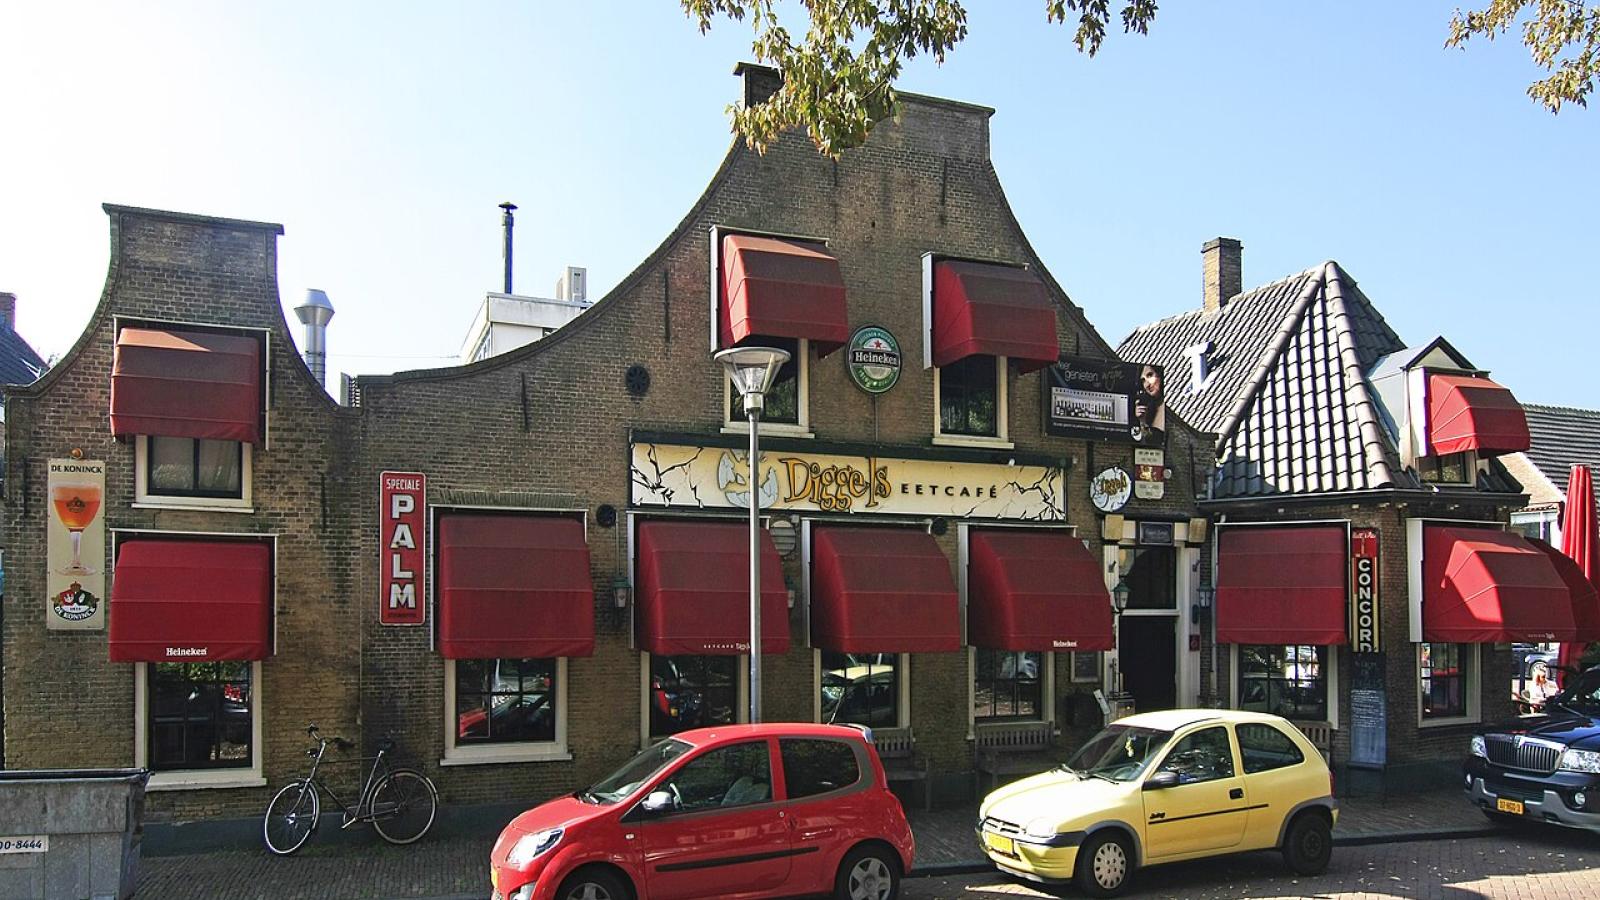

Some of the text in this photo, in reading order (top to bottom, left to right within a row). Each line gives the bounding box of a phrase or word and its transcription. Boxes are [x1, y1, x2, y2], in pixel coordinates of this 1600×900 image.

[855, 351, 897, 365] Heineken
[50, 464, 102, 474] DE KONINCK
[386, 478, 420, 491] SPECIALE
[779, 457, 997, 512] Diggels EETCAFÉ
[389, 493, 416, 609] PALM
[165, 647, 208, 657] Heineken
